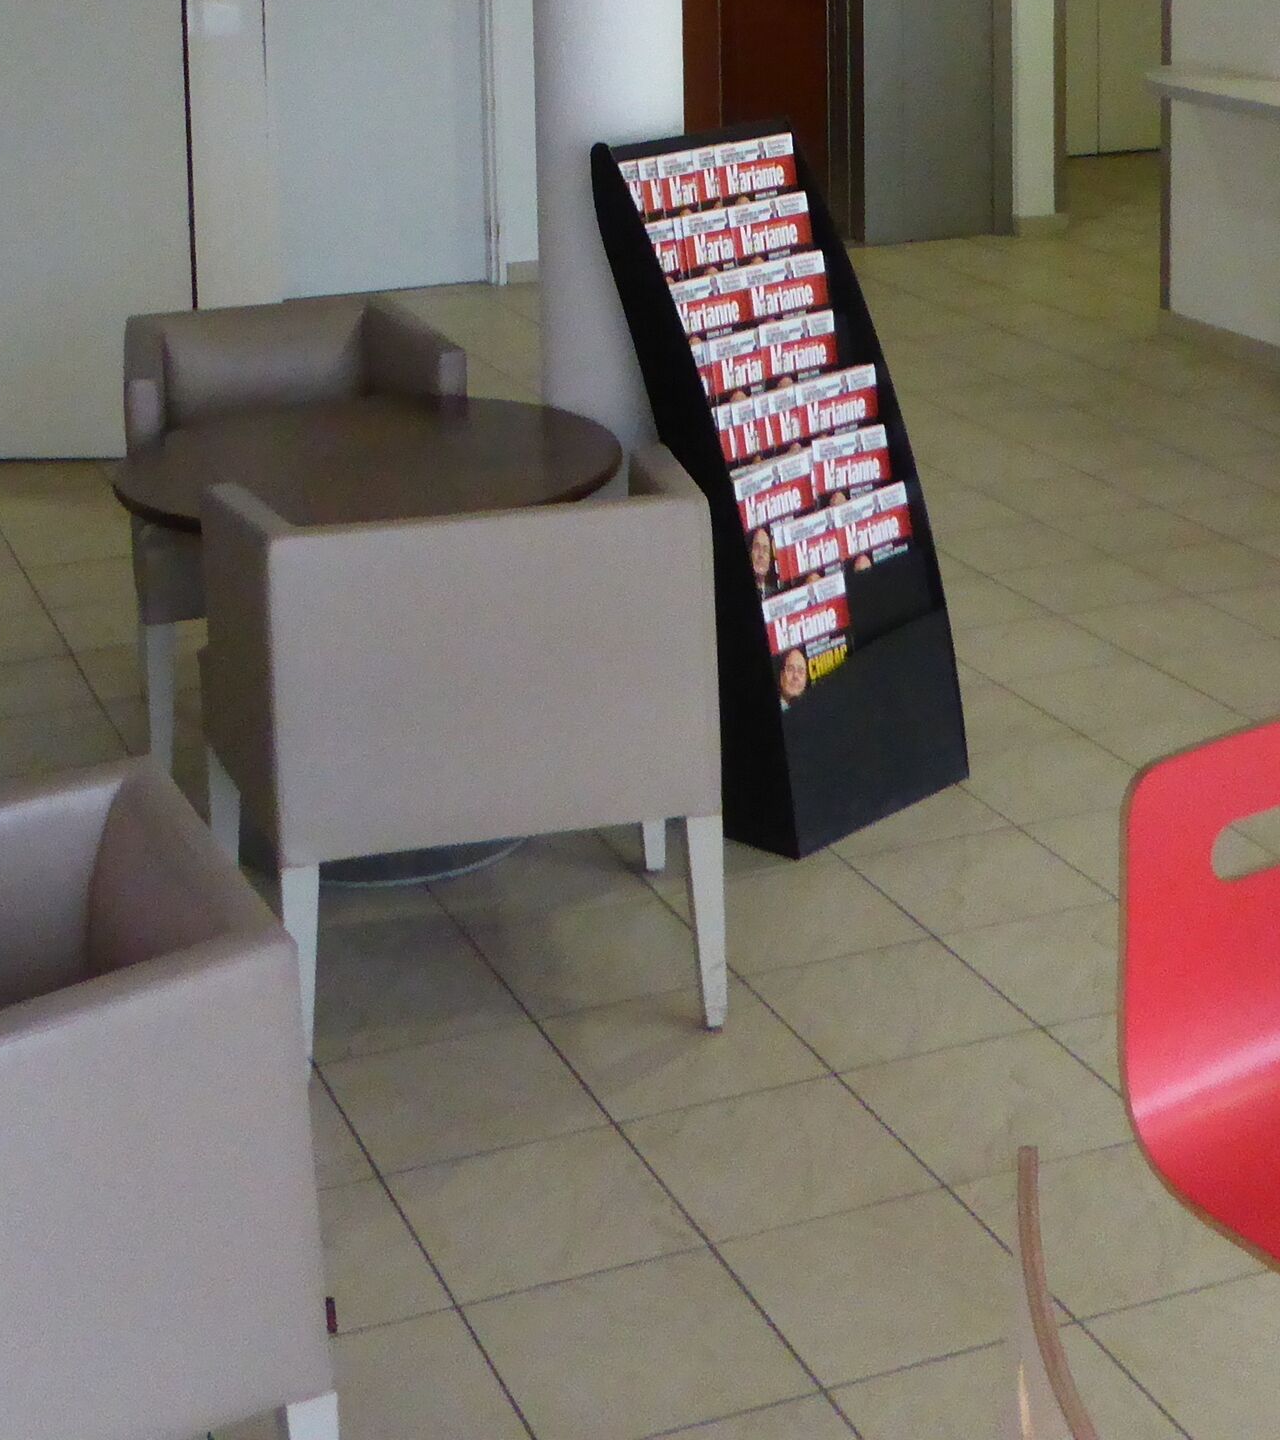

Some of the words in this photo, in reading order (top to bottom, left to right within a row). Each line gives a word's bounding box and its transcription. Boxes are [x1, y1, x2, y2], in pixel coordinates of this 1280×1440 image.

[726, 163, 785, 196] Marianne
[739, 222, 798, 256] Marianne
[676, 300, 740, 334] Marianne
[751, 284, 814, 317] Marianne
[770, 343, 827, 375] Marianne
[807, 397, 866, 433] Marianne
[823, 457, 880, 490] Marianne
[745, 486, 802, 530] Marianne
[845, 516, 900, 556] Marianne
[774, 607, 837, 650] Marianne
